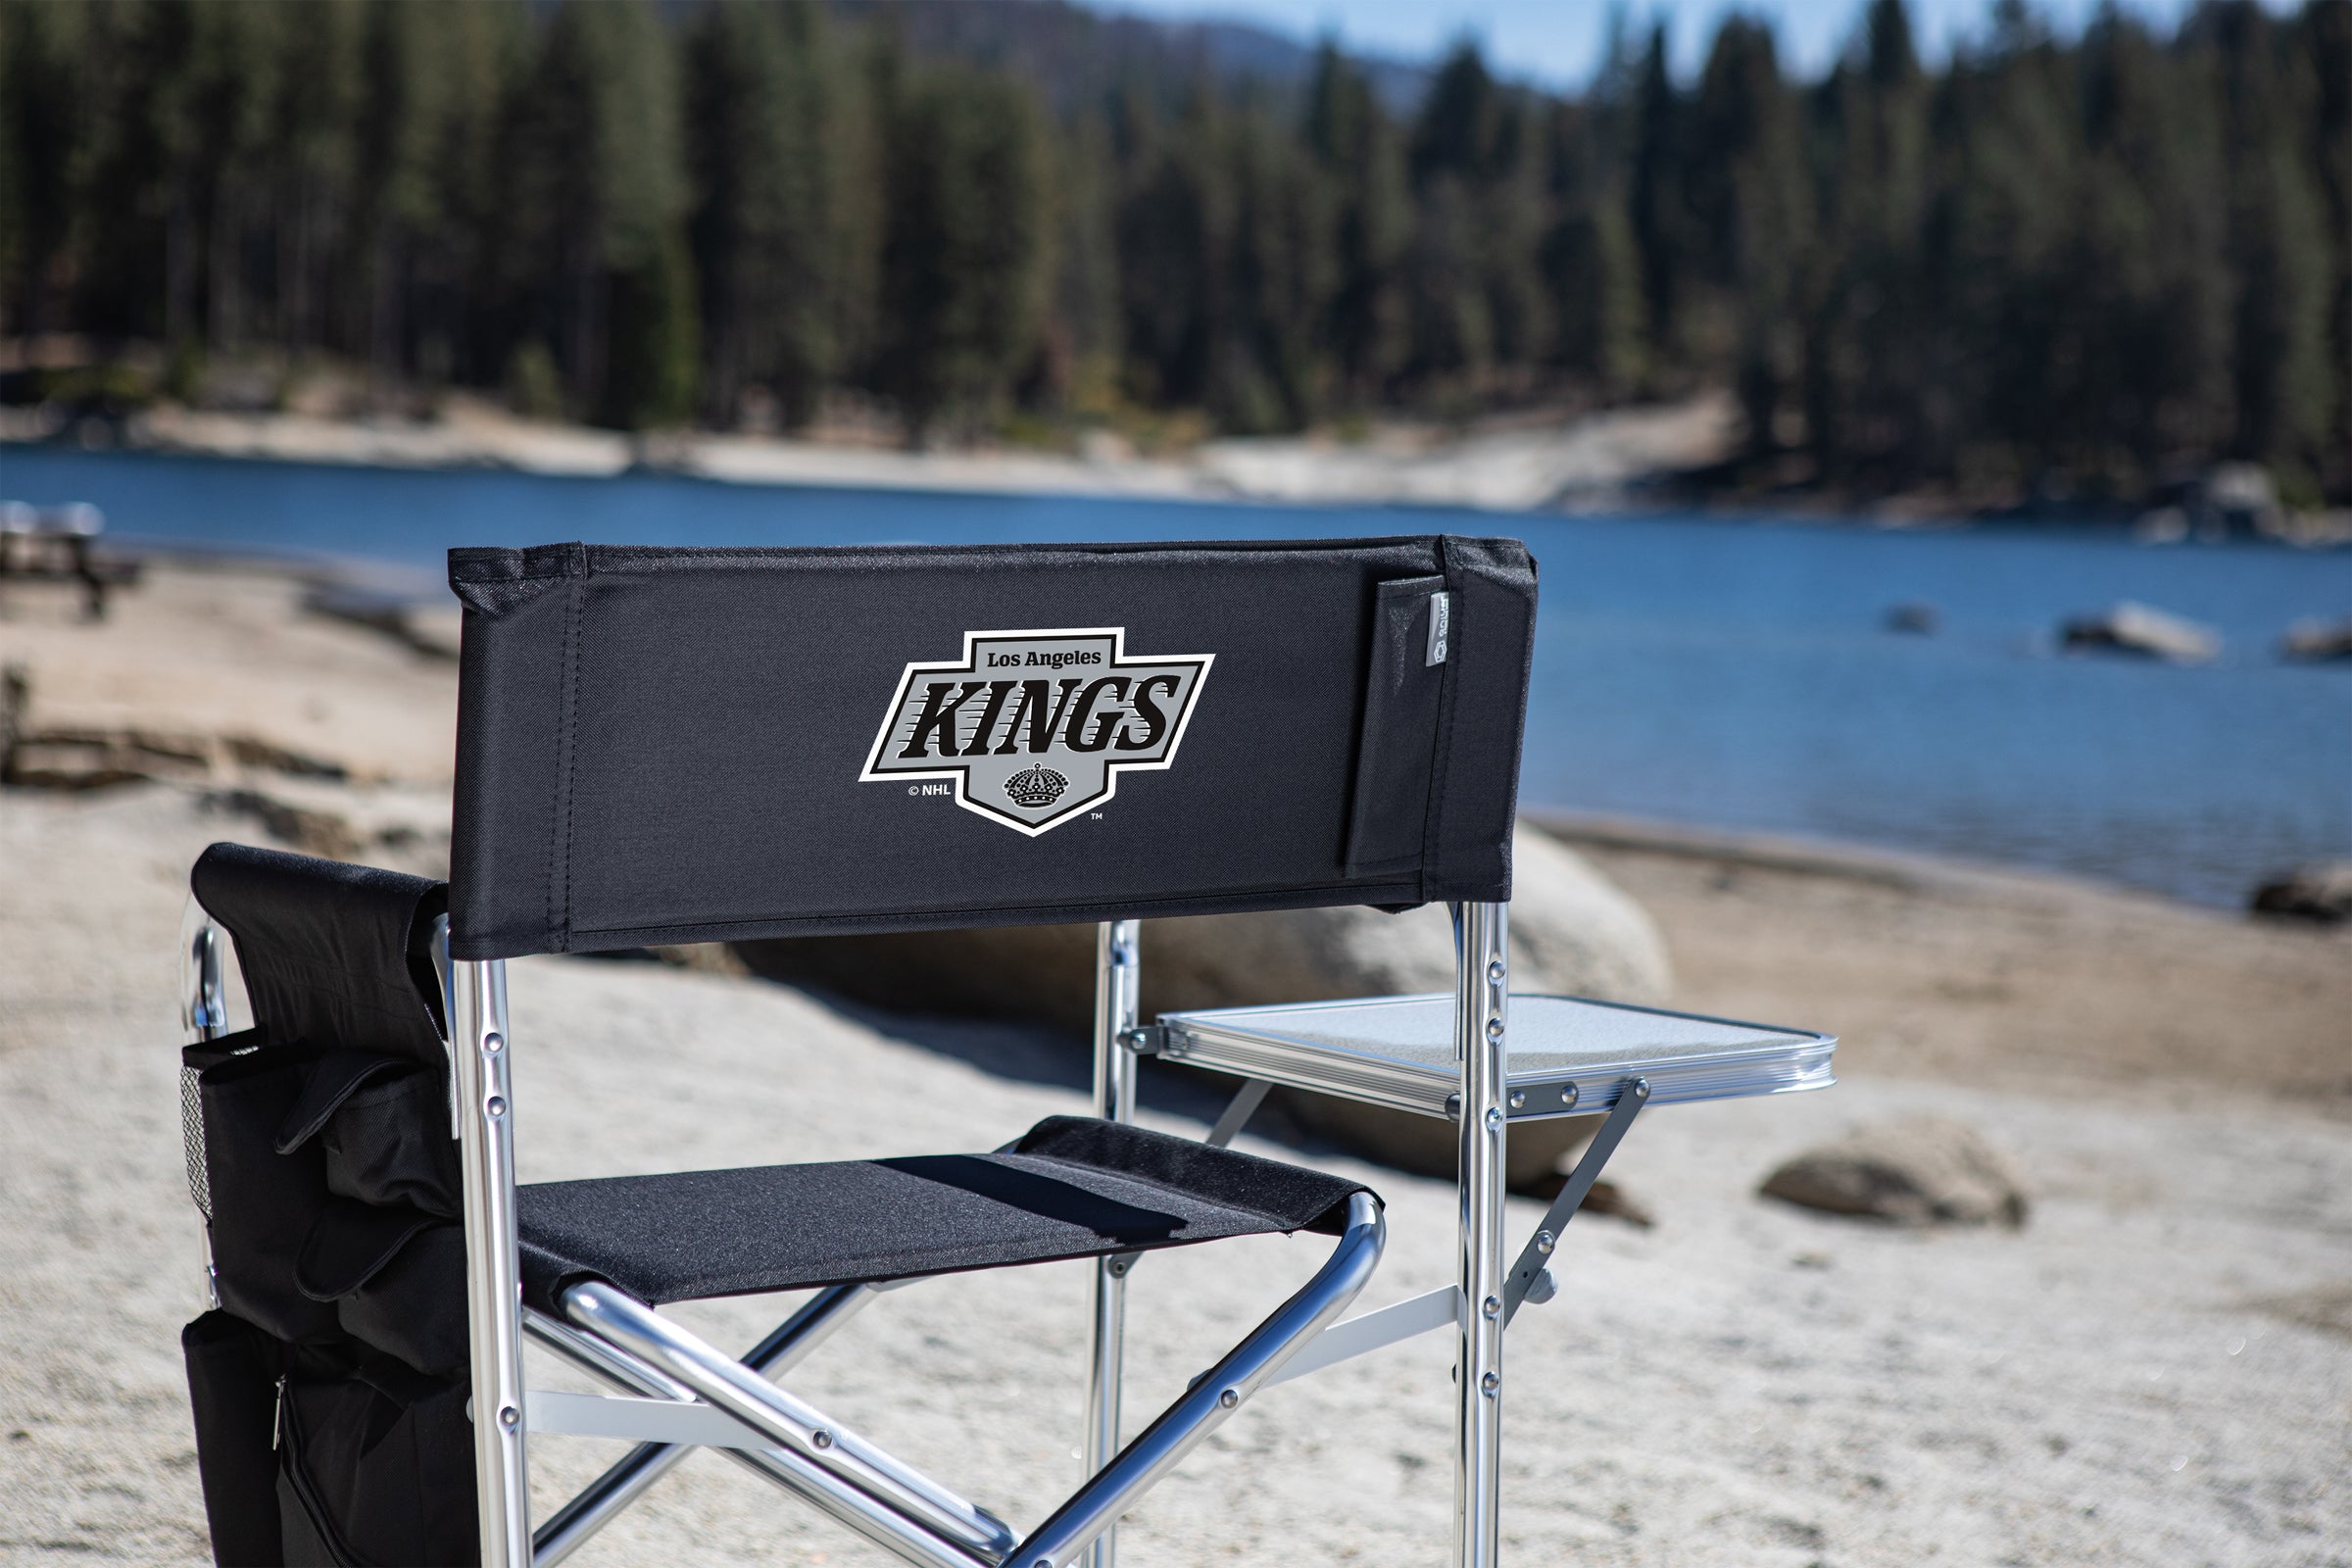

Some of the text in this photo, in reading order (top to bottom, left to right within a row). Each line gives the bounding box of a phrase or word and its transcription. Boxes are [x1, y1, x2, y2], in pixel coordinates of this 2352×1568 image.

[987, 650, 1102, 669] Los Angeles
[897, 674, 1182, 759] KINGS
[921, 784, 952, 796] NHL
